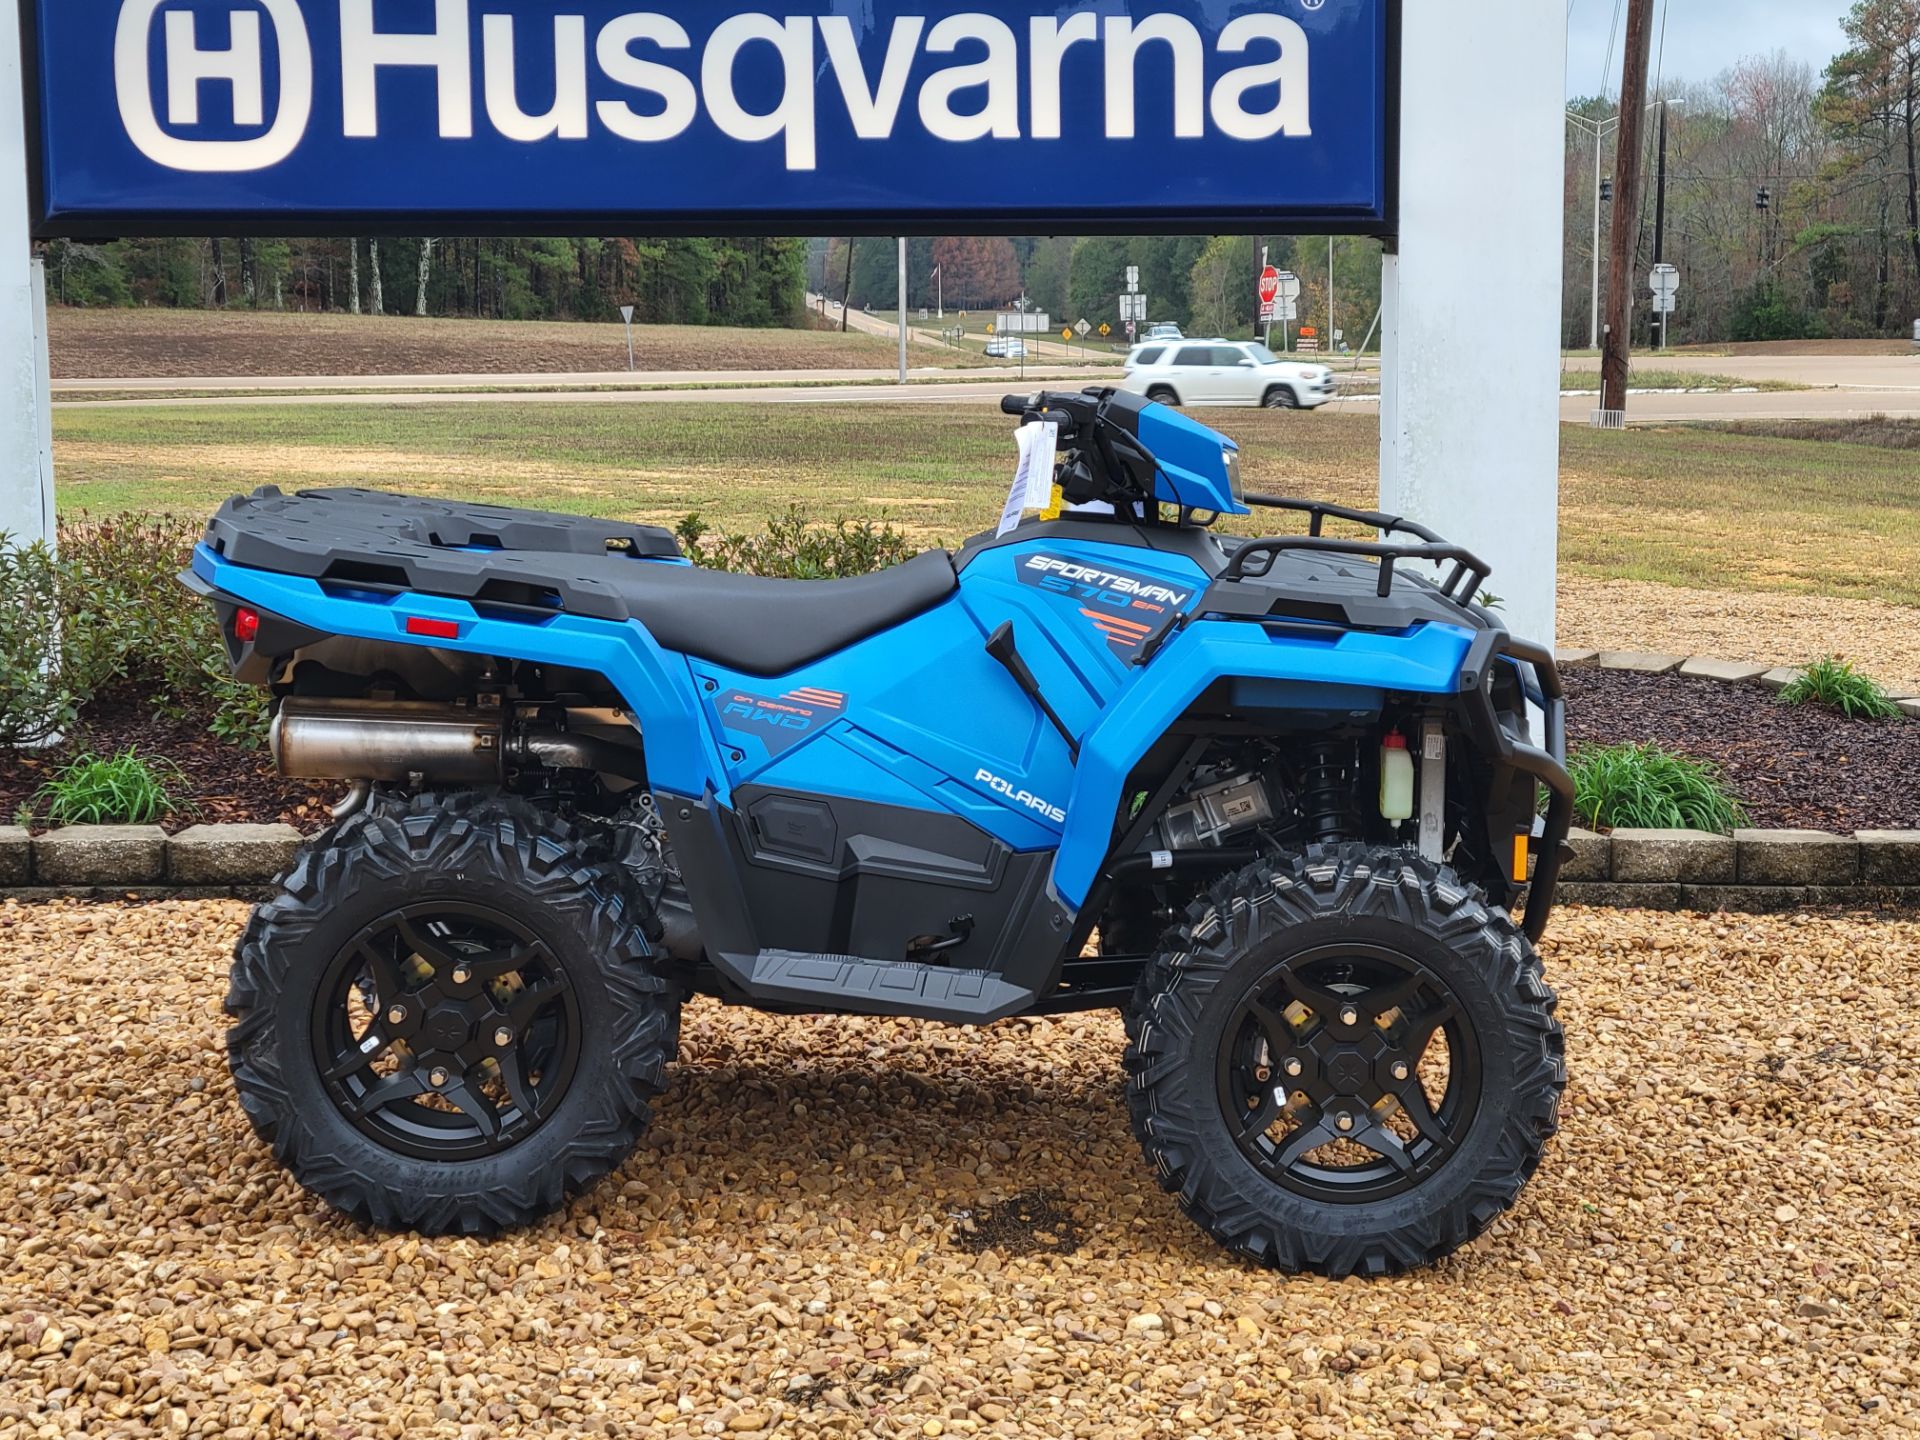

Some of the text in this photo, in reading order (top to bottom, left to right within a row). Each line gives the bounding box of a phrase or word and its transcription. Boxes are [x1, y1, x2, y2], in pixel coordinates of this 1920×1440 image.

[340, 0, 1312, 171] Husqvarna
[1261, 277, 1277, 292] STOP
[1024, 555, 1187, 606] SPORTSMAN
[1038, 575, 1132, 608] 570
[724, 703, 810, 729] AWD
[974, 768, 1066, 823] POLARIS
